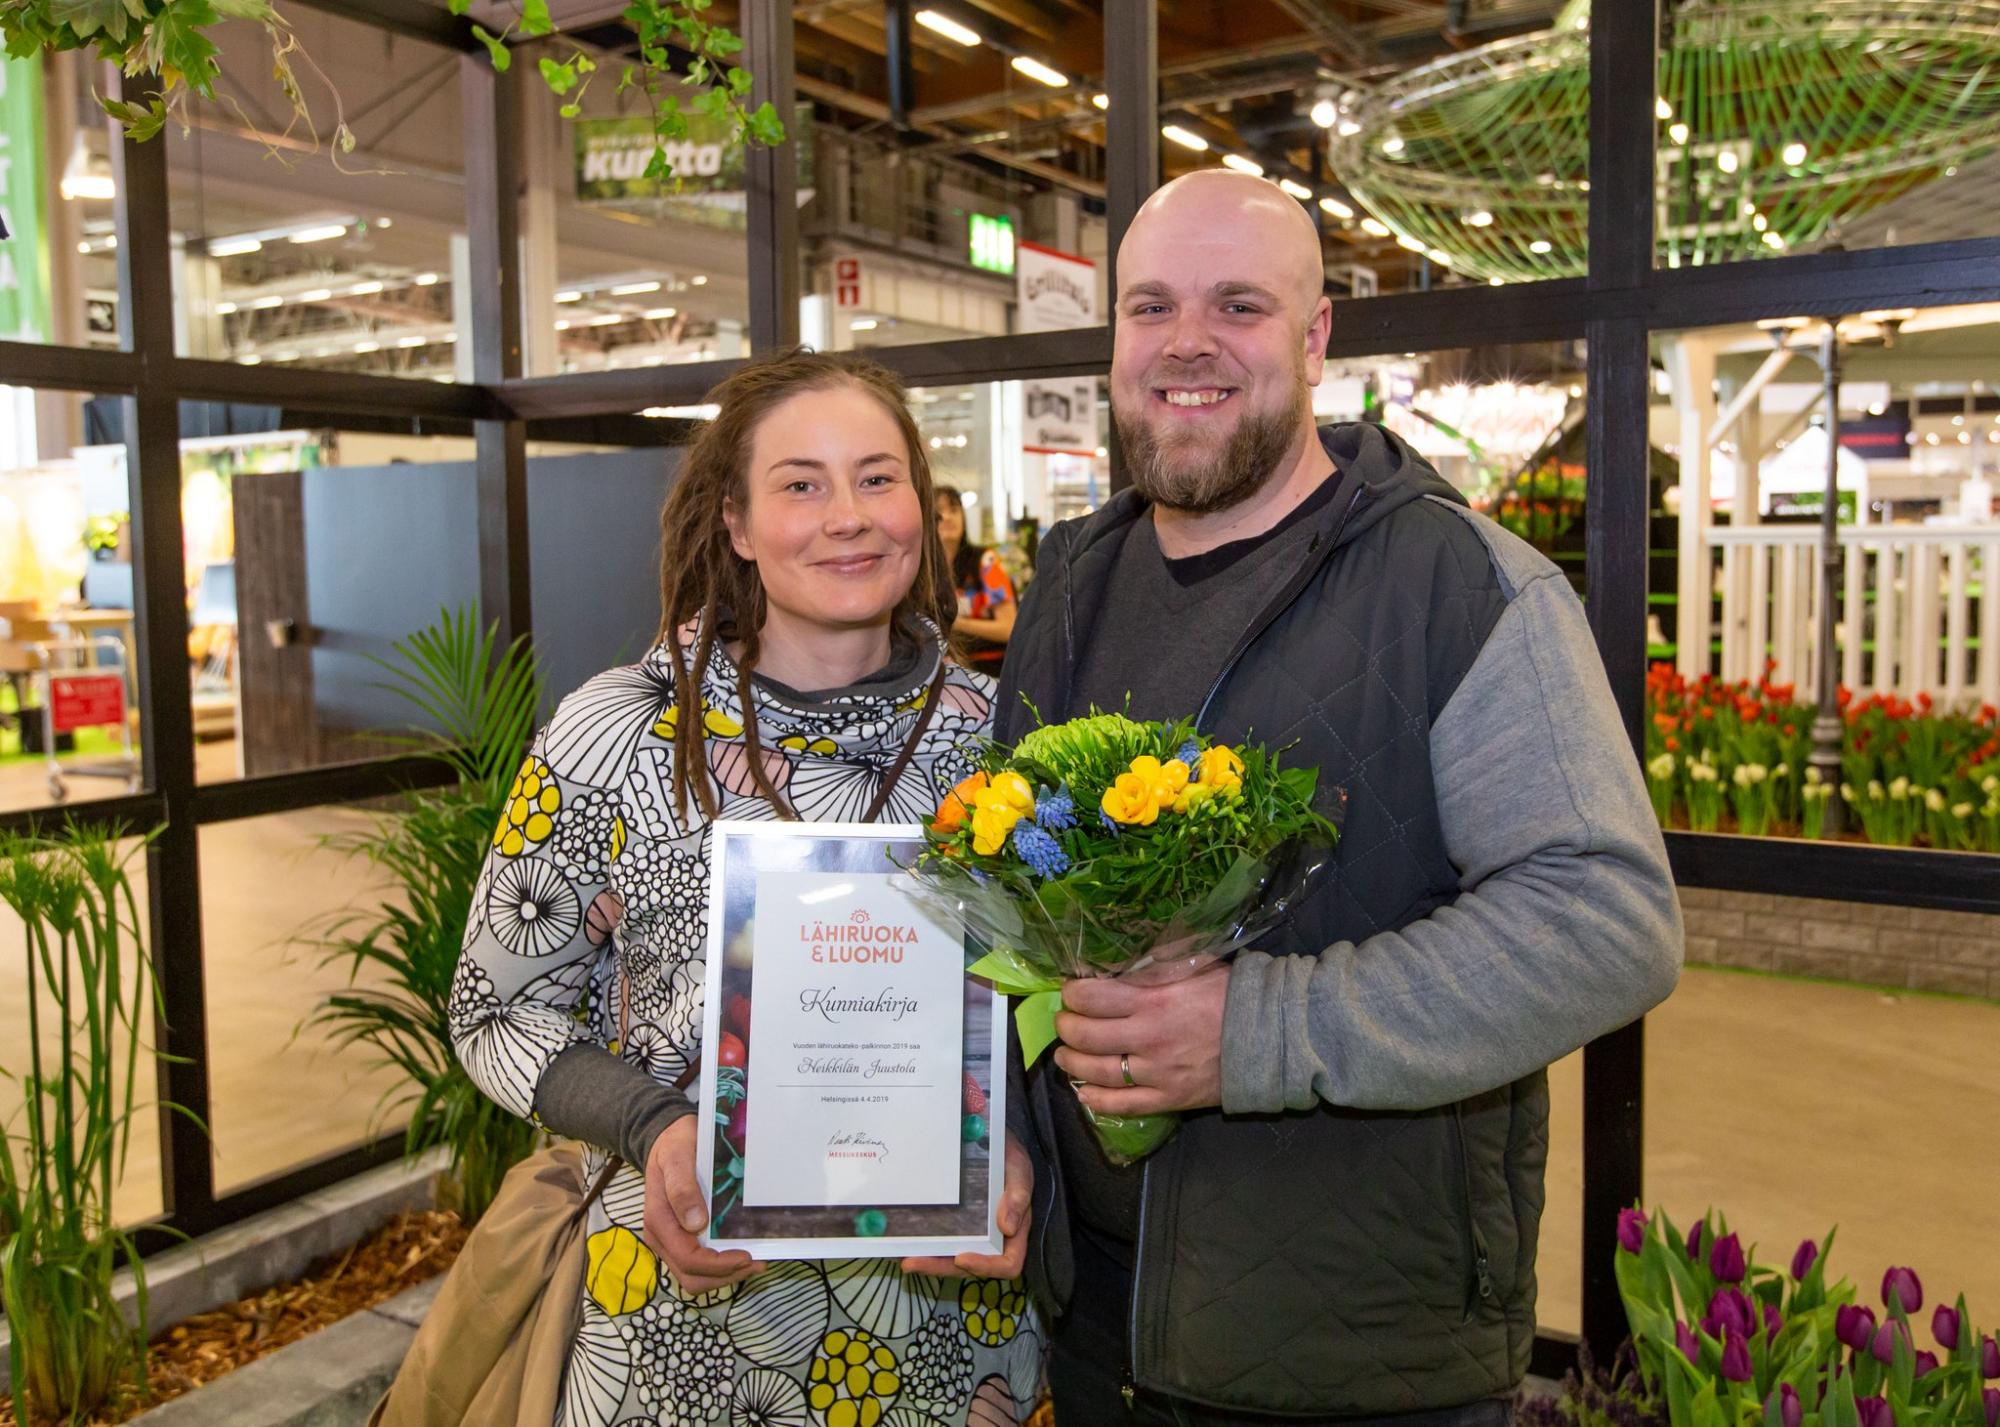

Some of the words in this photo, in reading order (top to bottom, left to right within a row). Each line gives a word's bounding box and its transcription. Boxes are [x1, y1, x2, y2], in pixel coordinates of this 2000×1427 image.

[801, 921, 919, 943] LÄHIRUOKA
[812, 945, 823, 963] &
[829, 946, 904, 963] LUOMU
[800, 986, 918, 1023] Kunniakirja
[797, 1056, 860, 1074] Heikkilän
[863, 1058, 917, 1079] Juustola
